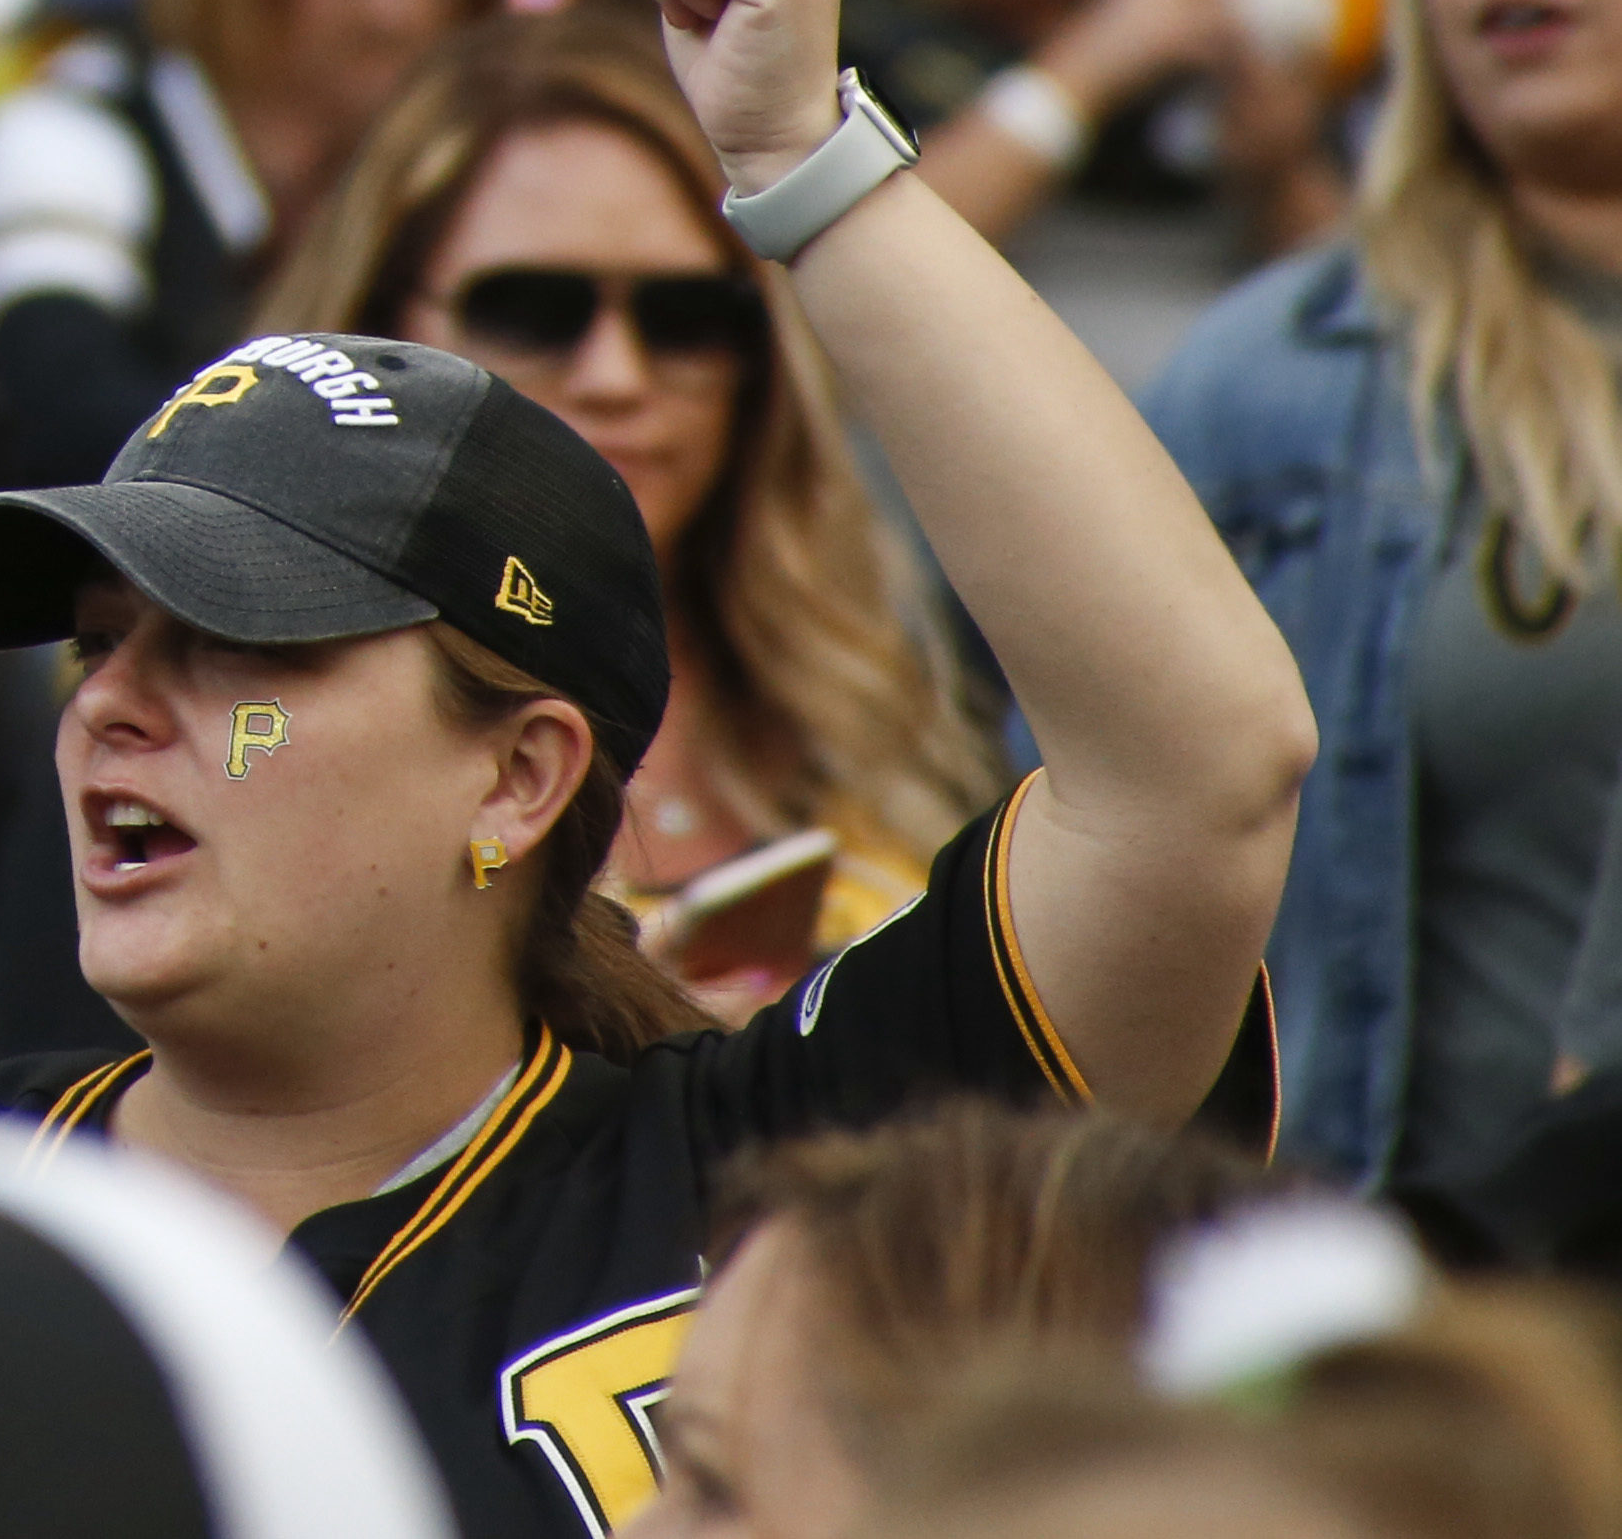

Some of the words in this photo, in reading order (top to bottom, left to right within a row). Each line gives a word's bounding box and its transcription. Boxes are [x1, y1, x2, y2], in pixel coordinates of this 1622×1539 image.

[147, 365, 259, 439] P
[223, 698, 293, 781] P
[469, 836, 508, 890] P
